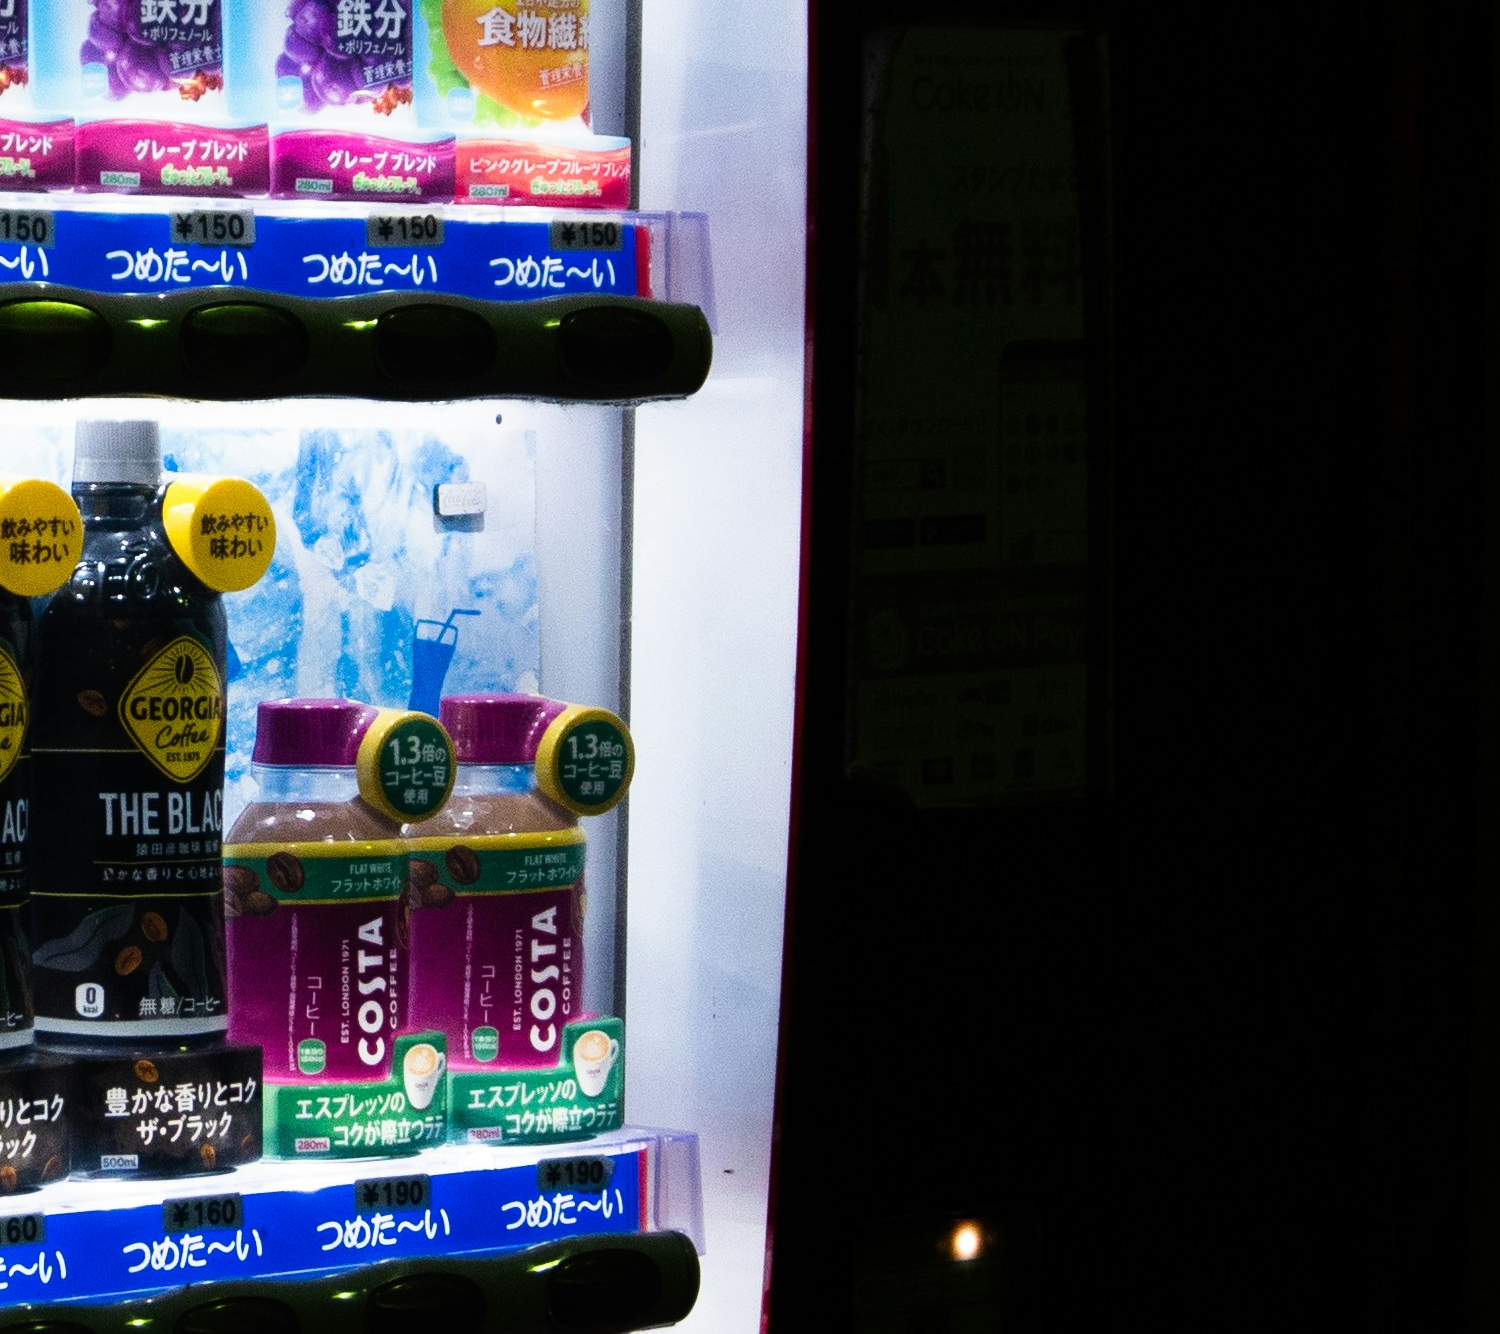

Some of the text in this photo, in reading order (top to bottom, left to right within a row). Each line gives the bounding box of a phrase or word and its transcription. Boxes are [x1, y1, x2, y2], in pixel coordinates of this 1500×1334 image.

[377, 214, 438, 241] ¥150
[1, 516, 75, 539] 飲みやすい
[10, 541, 70, 566] 味わい
[389, 735, 446, 766] 1.3倍の
[386, 764, 445, 787] コーヒー豆
[404, 789, 428, 806] 使用
[358, 915, 384, 1066] COSTA
[389, 948, 398, 1031] COFFEE
[531, 905, 557, 1052] COSTA
[86, 987, 97, 1005] 0
[296, 1089, 405, 1120] エスプレッソの
[333, 1114, 443, 1146] コクが際立つラテ
[364, 1180, 423, 1207] ¥190
